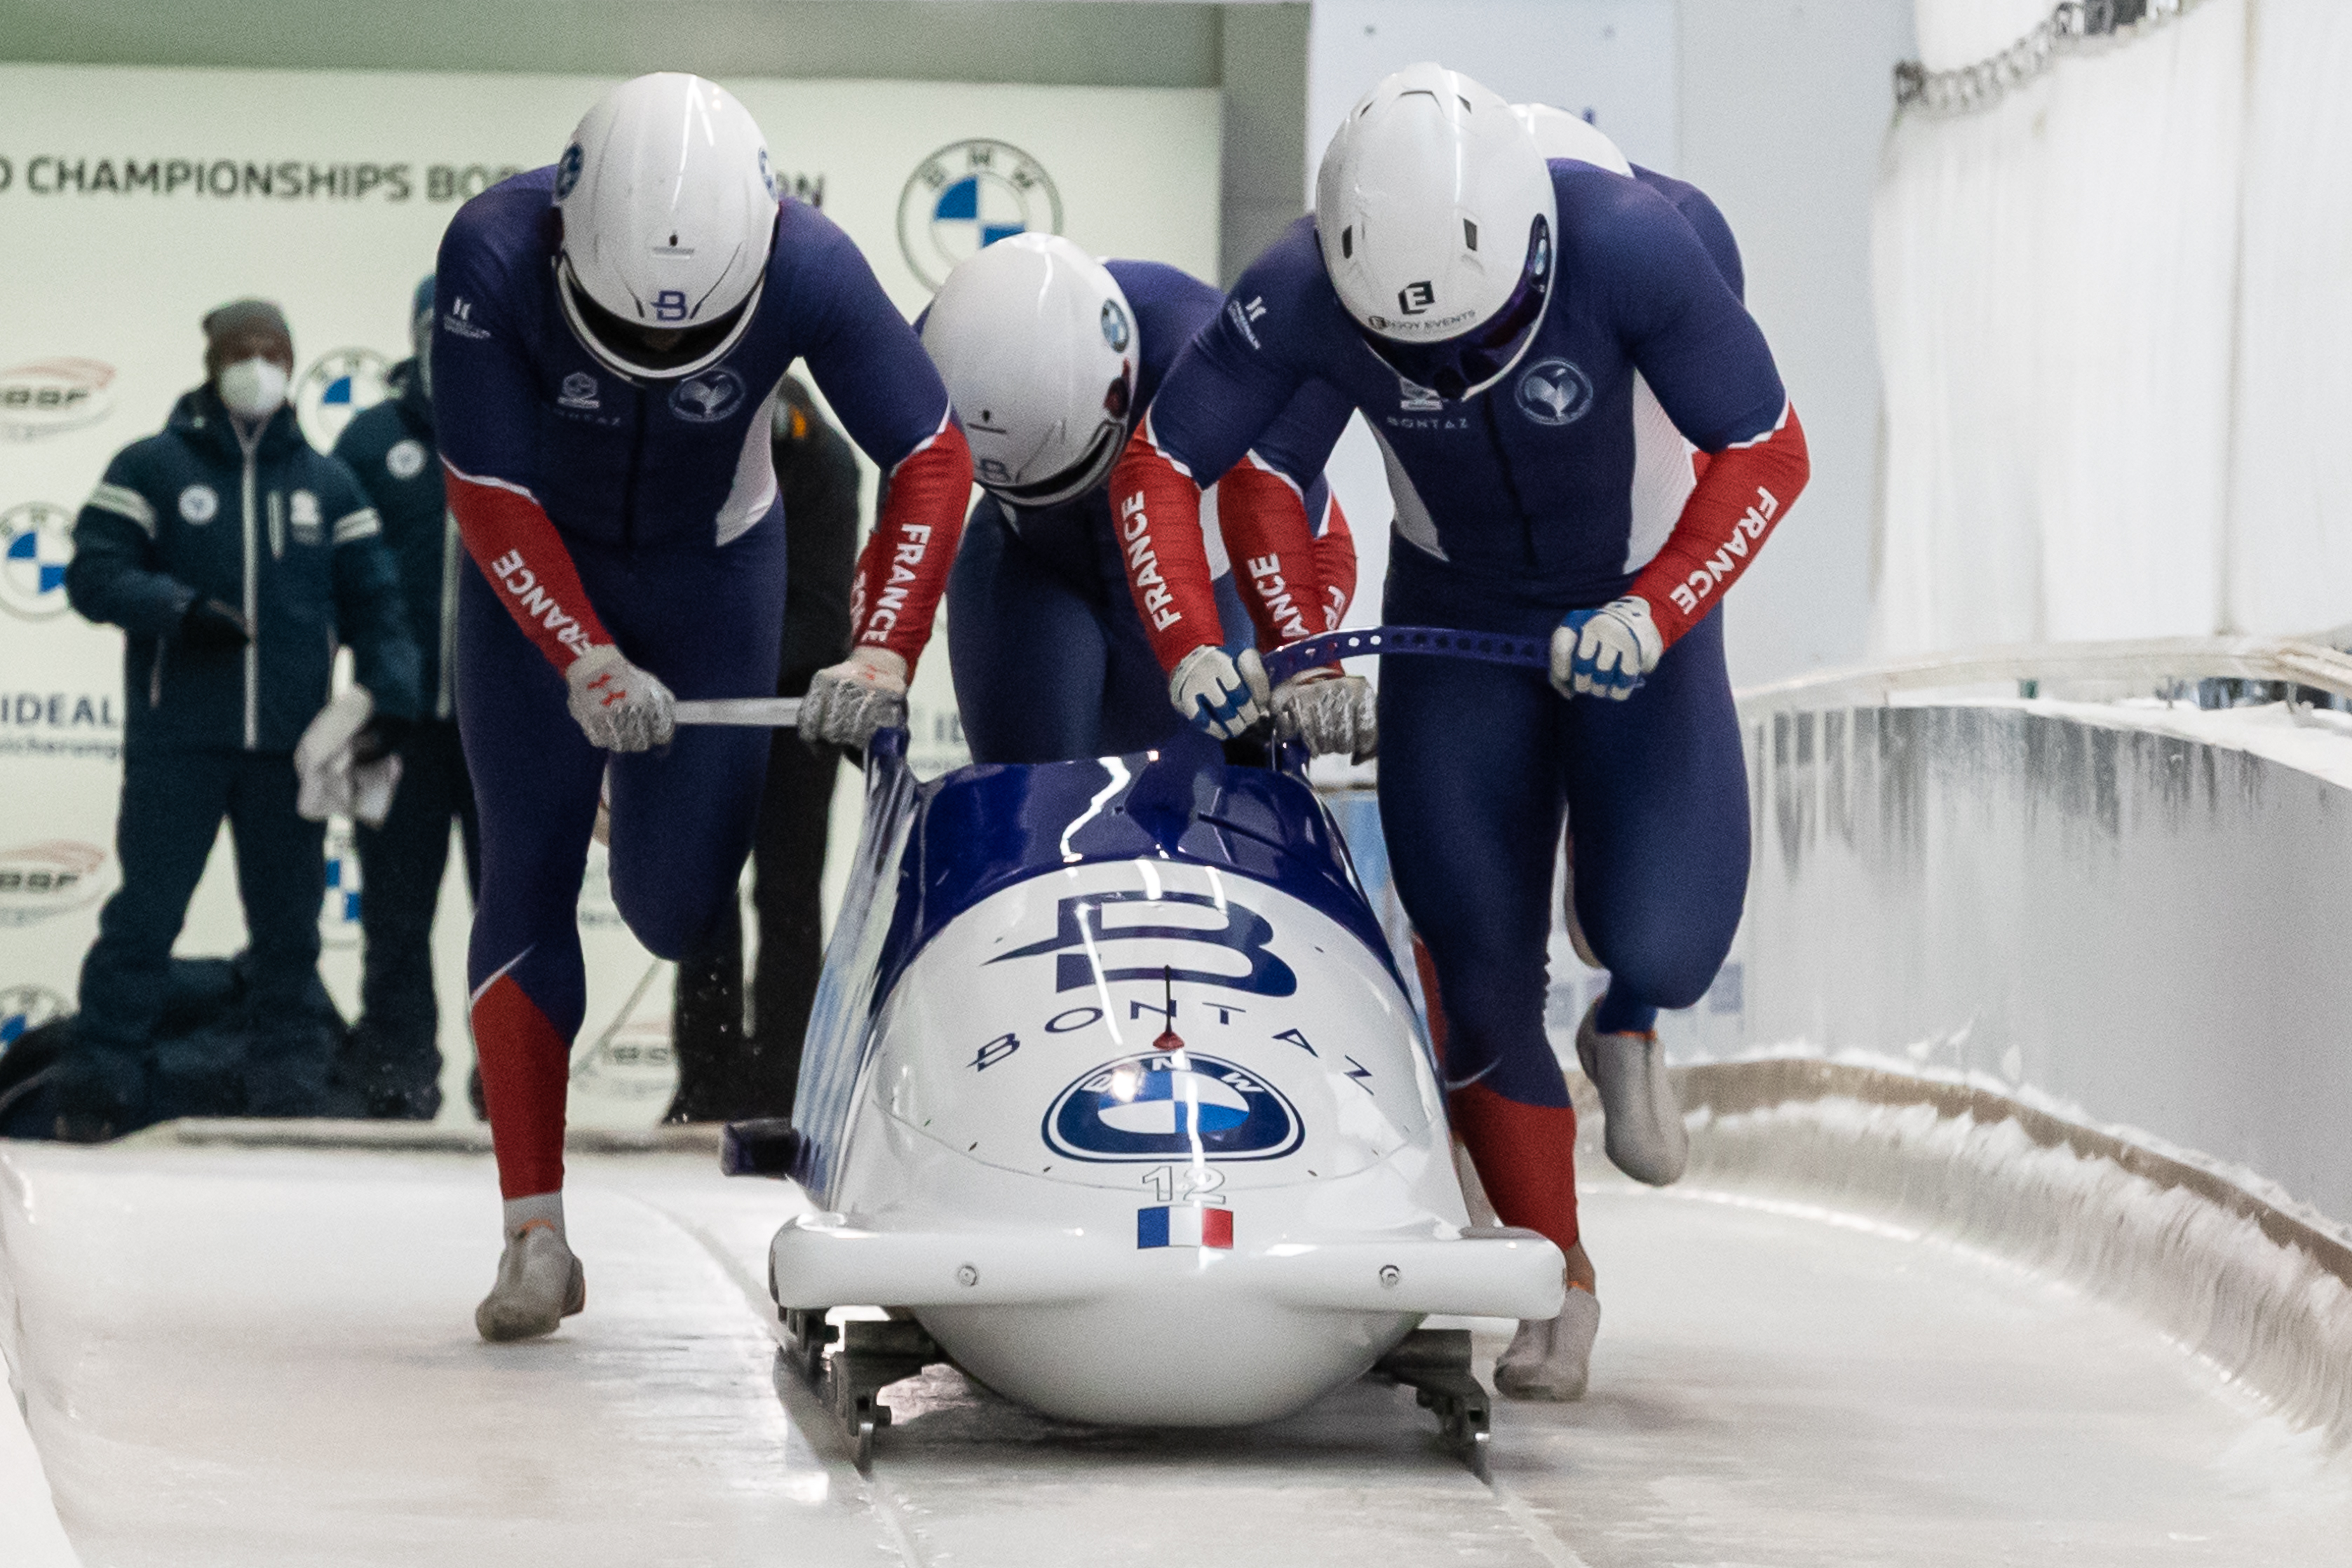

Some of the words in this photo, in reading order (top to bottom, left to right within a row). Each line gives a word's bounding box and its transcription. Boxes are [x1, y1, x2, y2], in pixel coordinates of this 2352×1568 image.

[27, 156, 413, 201] CHAMPIONSHIPS
[857, 523, 932, 643] FRANCE
[1121, 490, 1182, 632] FRANCE
[1247, 552, 1310, 637] ANCE
[1669, 485, 1779, 615] FRANCE
[492, 548, 593, 658] FRANCE
[1, 691, 118, 728] IDEAL
[965, 999, 1374, 1095] BONTAZ
[1142, 1165, 1227, 1205] 12
